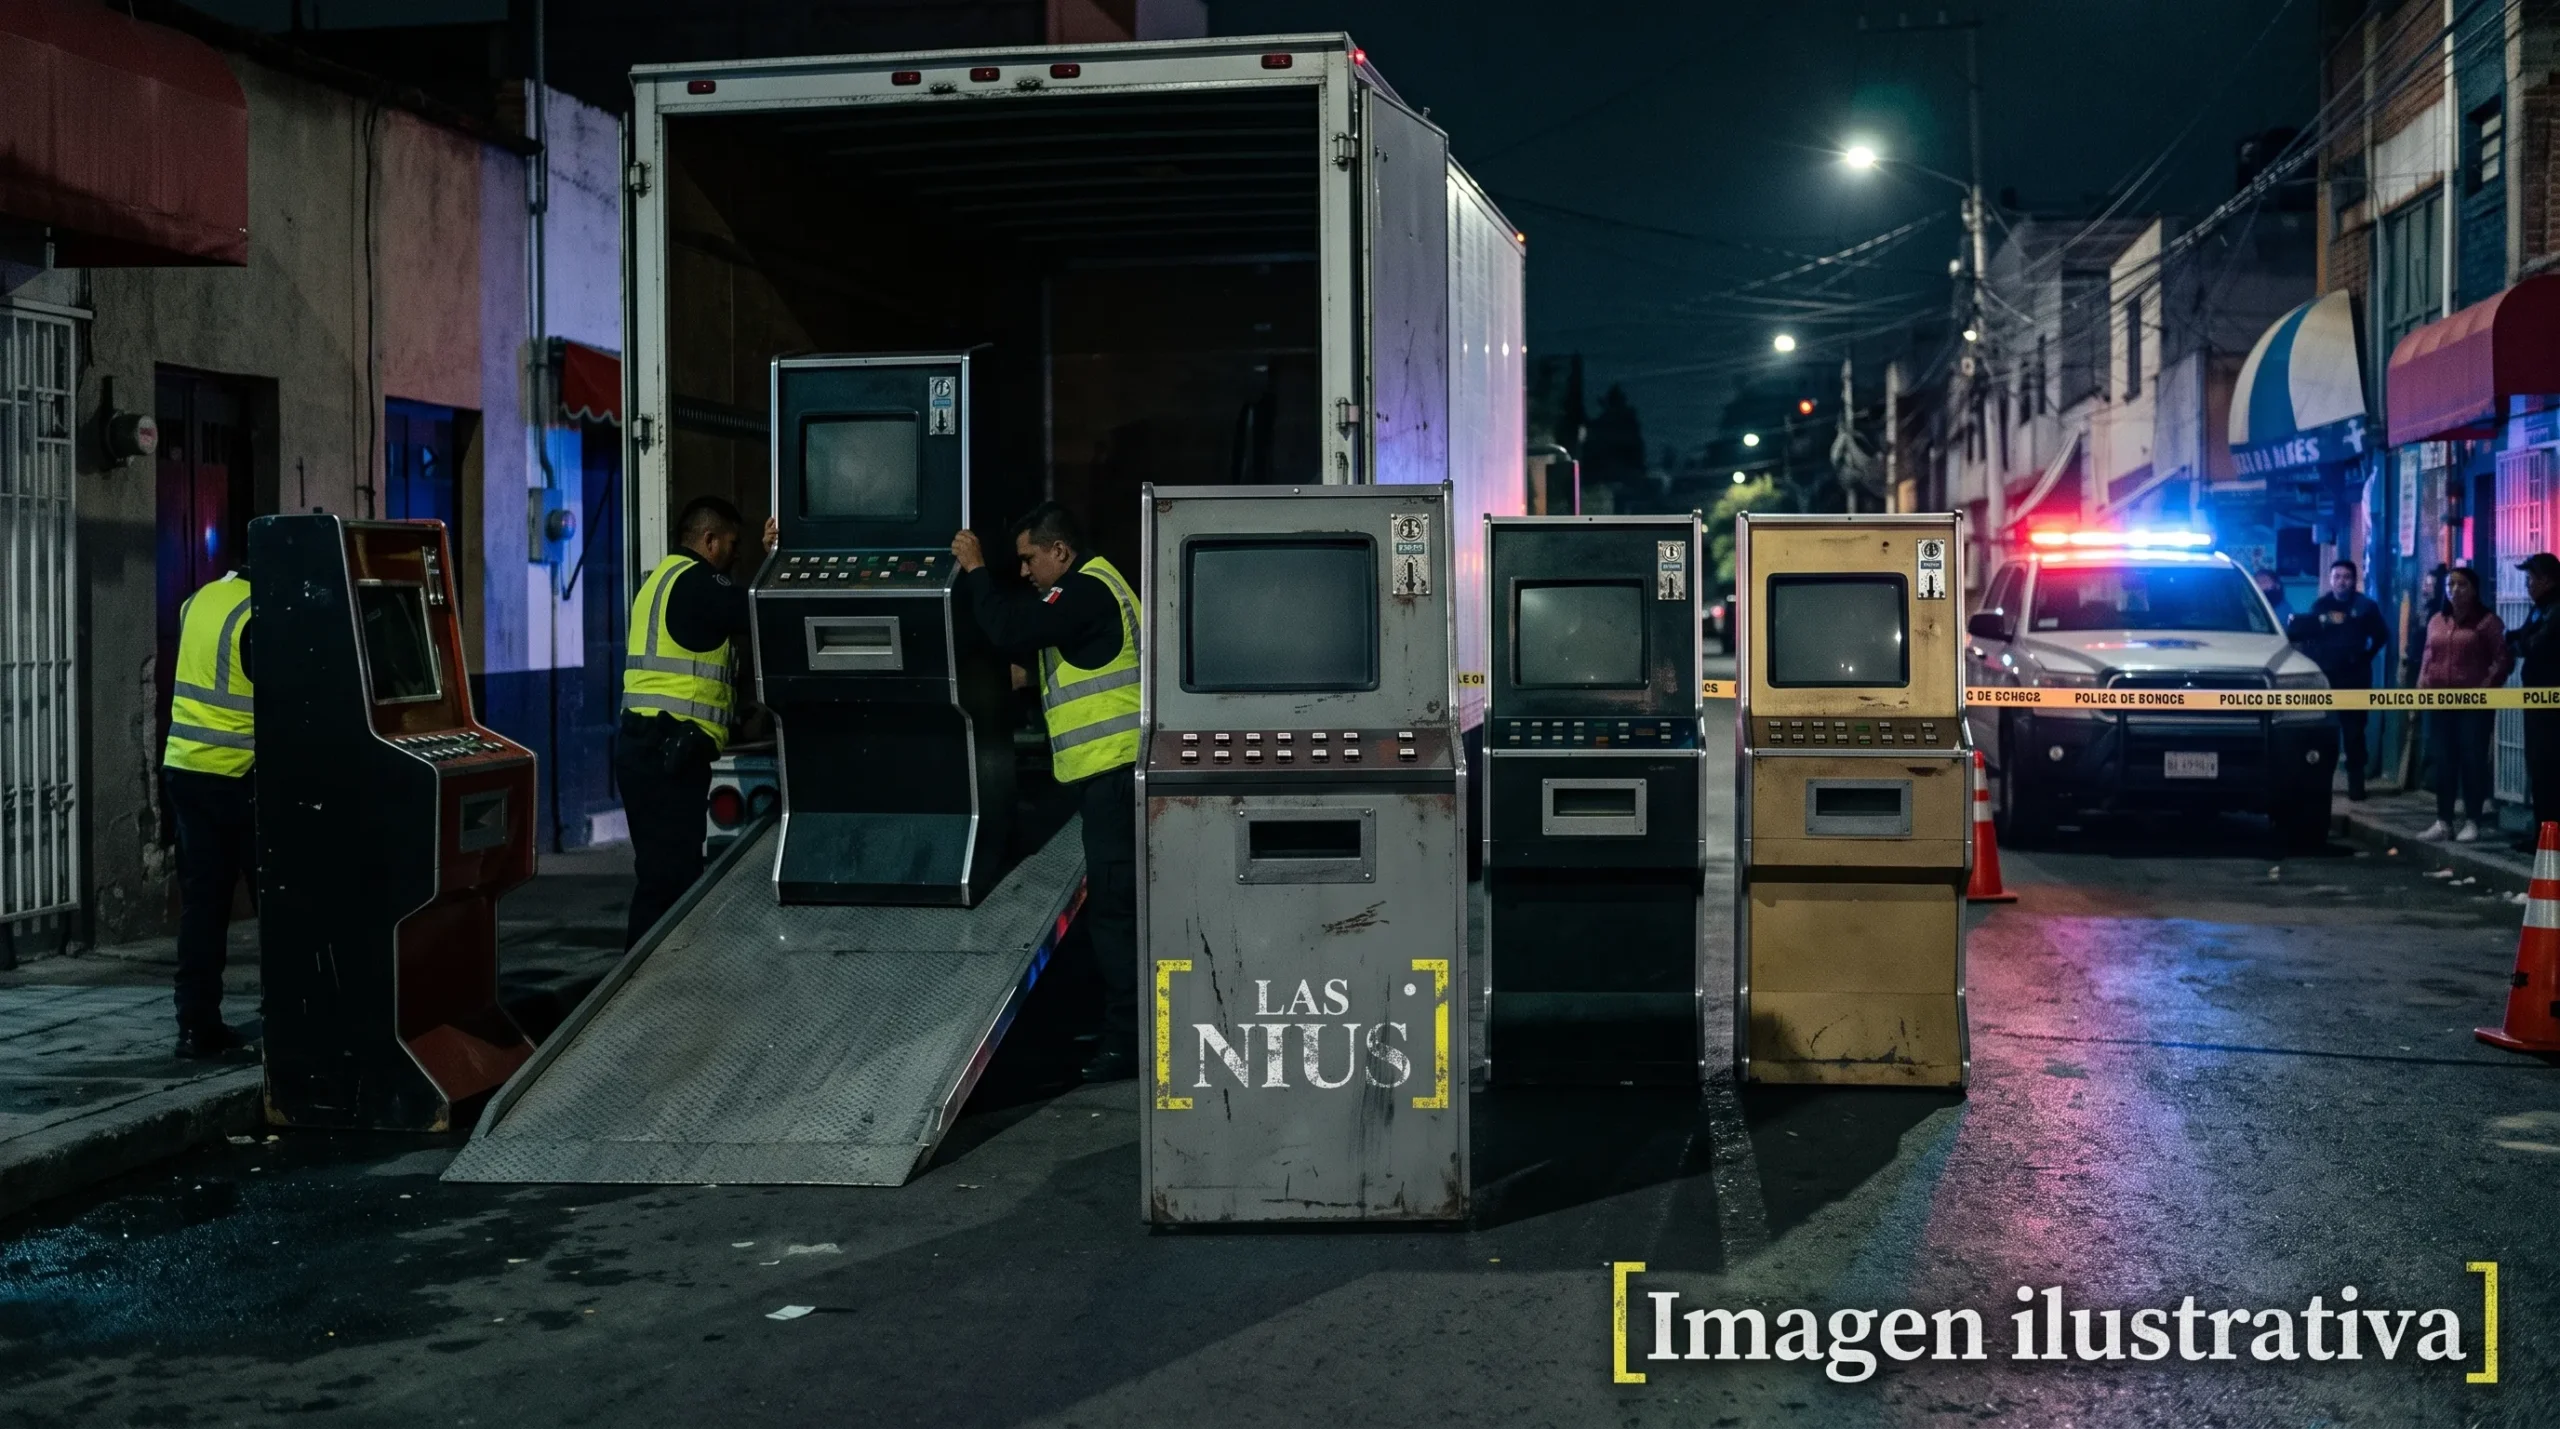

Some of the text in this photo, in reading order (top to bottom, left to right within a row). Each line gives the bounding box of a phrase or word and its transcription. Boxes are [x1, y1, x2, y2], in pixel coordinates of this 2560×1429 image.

[1977, 690, 1992, 701] DE
[2120, 693, 2136, 704] DE
[2267, 694, 2282, 705] DE
[2418, 693, 2434, 705] DE
